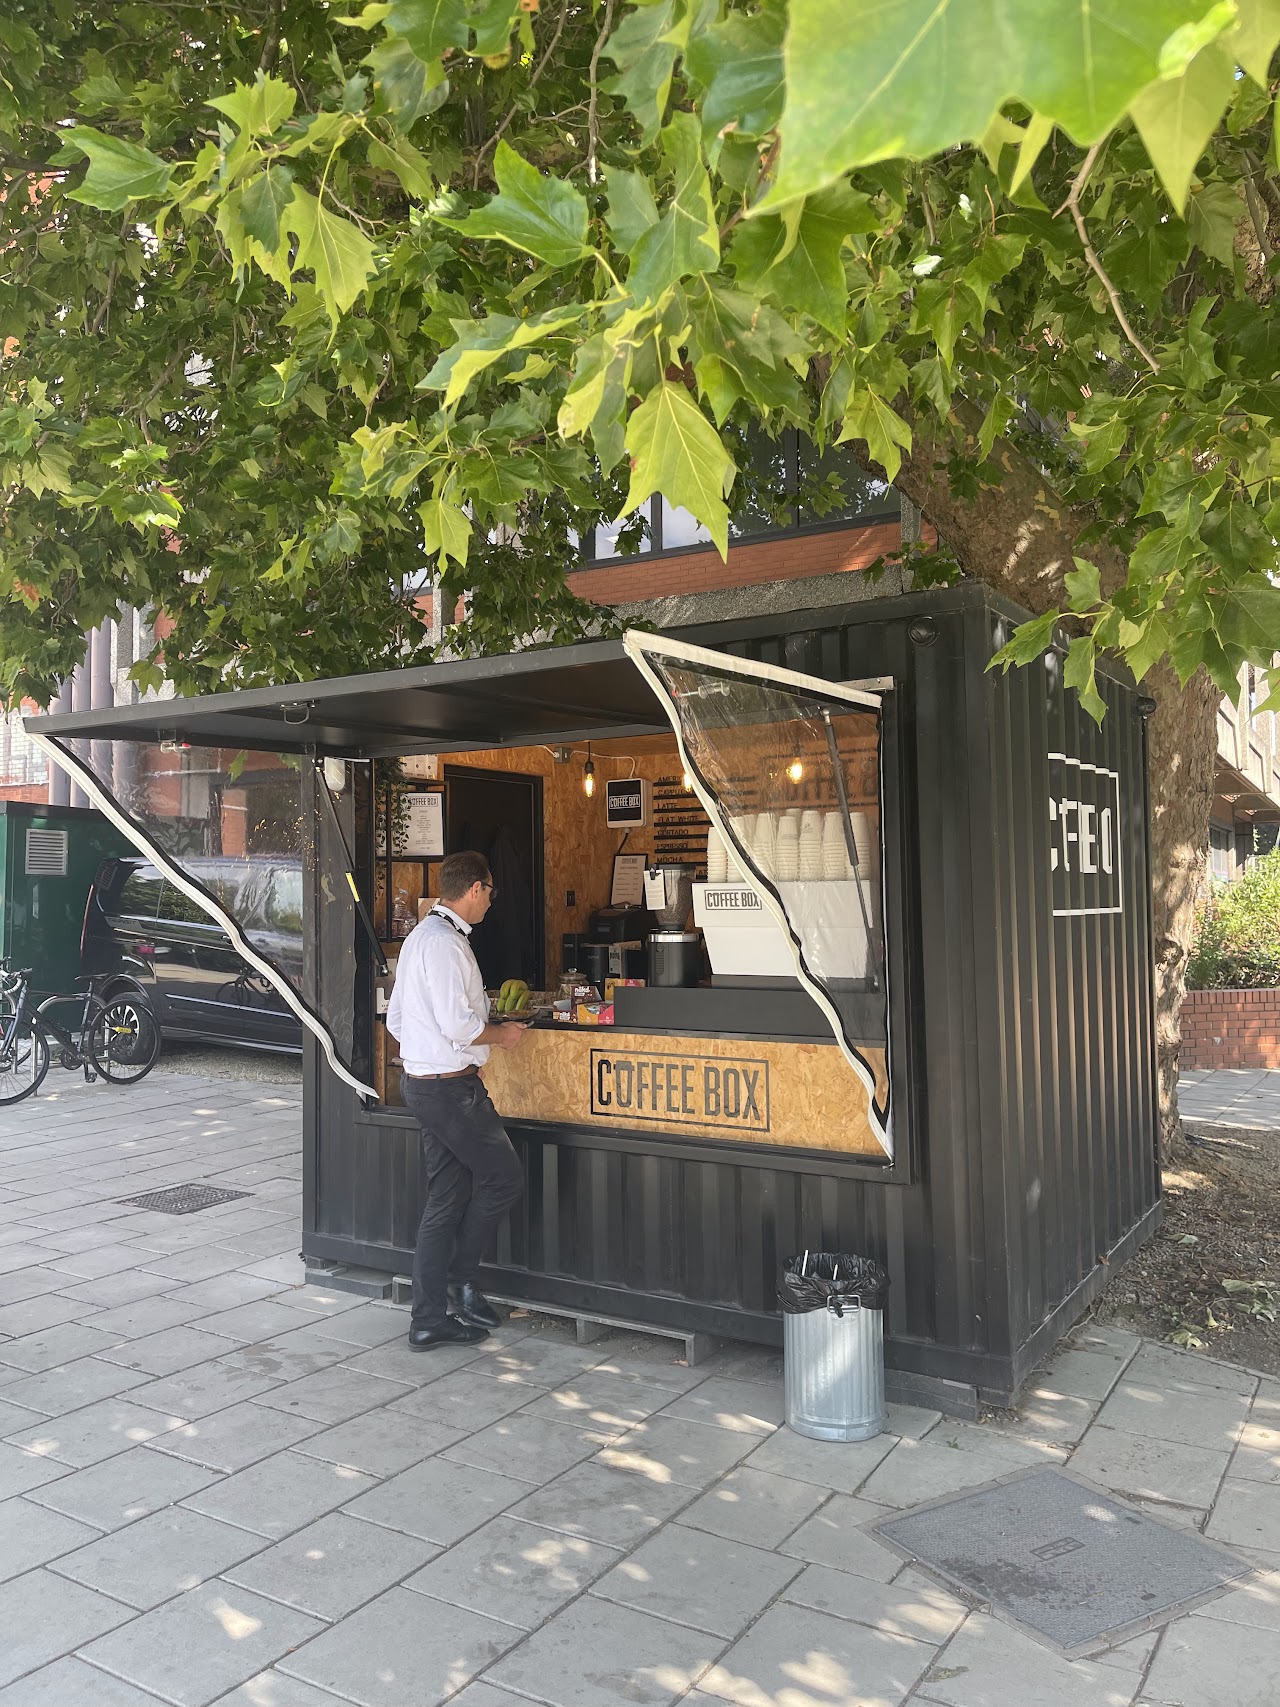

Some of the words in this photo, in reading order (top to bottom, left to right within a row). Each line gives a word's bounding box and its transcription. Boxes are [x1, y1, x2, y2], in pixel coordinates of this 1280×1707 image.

[610, 796, 629, 808] COFFEE
[628, 796, 639, 806] BOX
[657, 802, 678, 810] LATTE
[657, 828, 689, 836] CORTADO
[707, 892, 740, 907] COFFEE
[741, 891, 760, 907] BOX
[108, 917, 137, 925] TRANSIT
[597, 1059, 696, 1114] COFFEE
[703, 1066, 760, 1121] BOX
